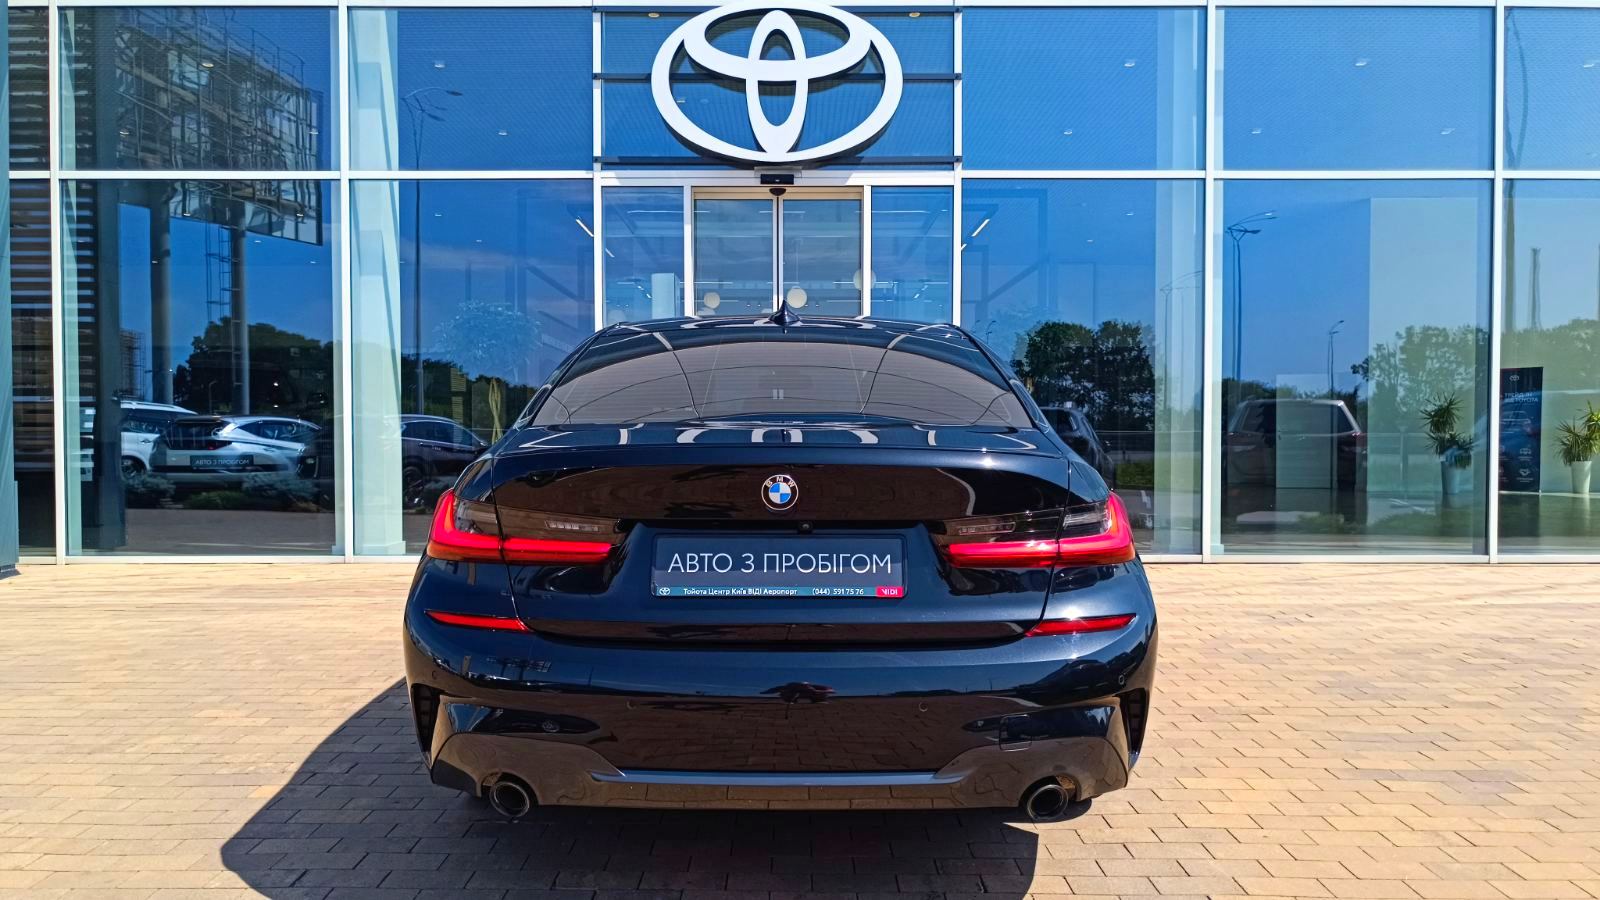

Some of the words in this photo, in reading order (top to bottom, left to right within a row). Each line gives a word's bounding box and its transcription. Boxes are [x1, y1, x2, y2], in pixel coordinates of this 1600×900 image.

[765, 476, 795, 488] BMW
[667, 553, 733, 573] АВТО
[741, 553, 755, 573] З
[764, 553, 891, 573] ПРОБІГОМ
[683, 587, 707, 595] Тойота
[708, 588, 730, 596] Центр
[731, 587, 747, 595] Київ
[763, 588, 798, 596] Аеропорт
[812, 588, 830, 596] (044)
